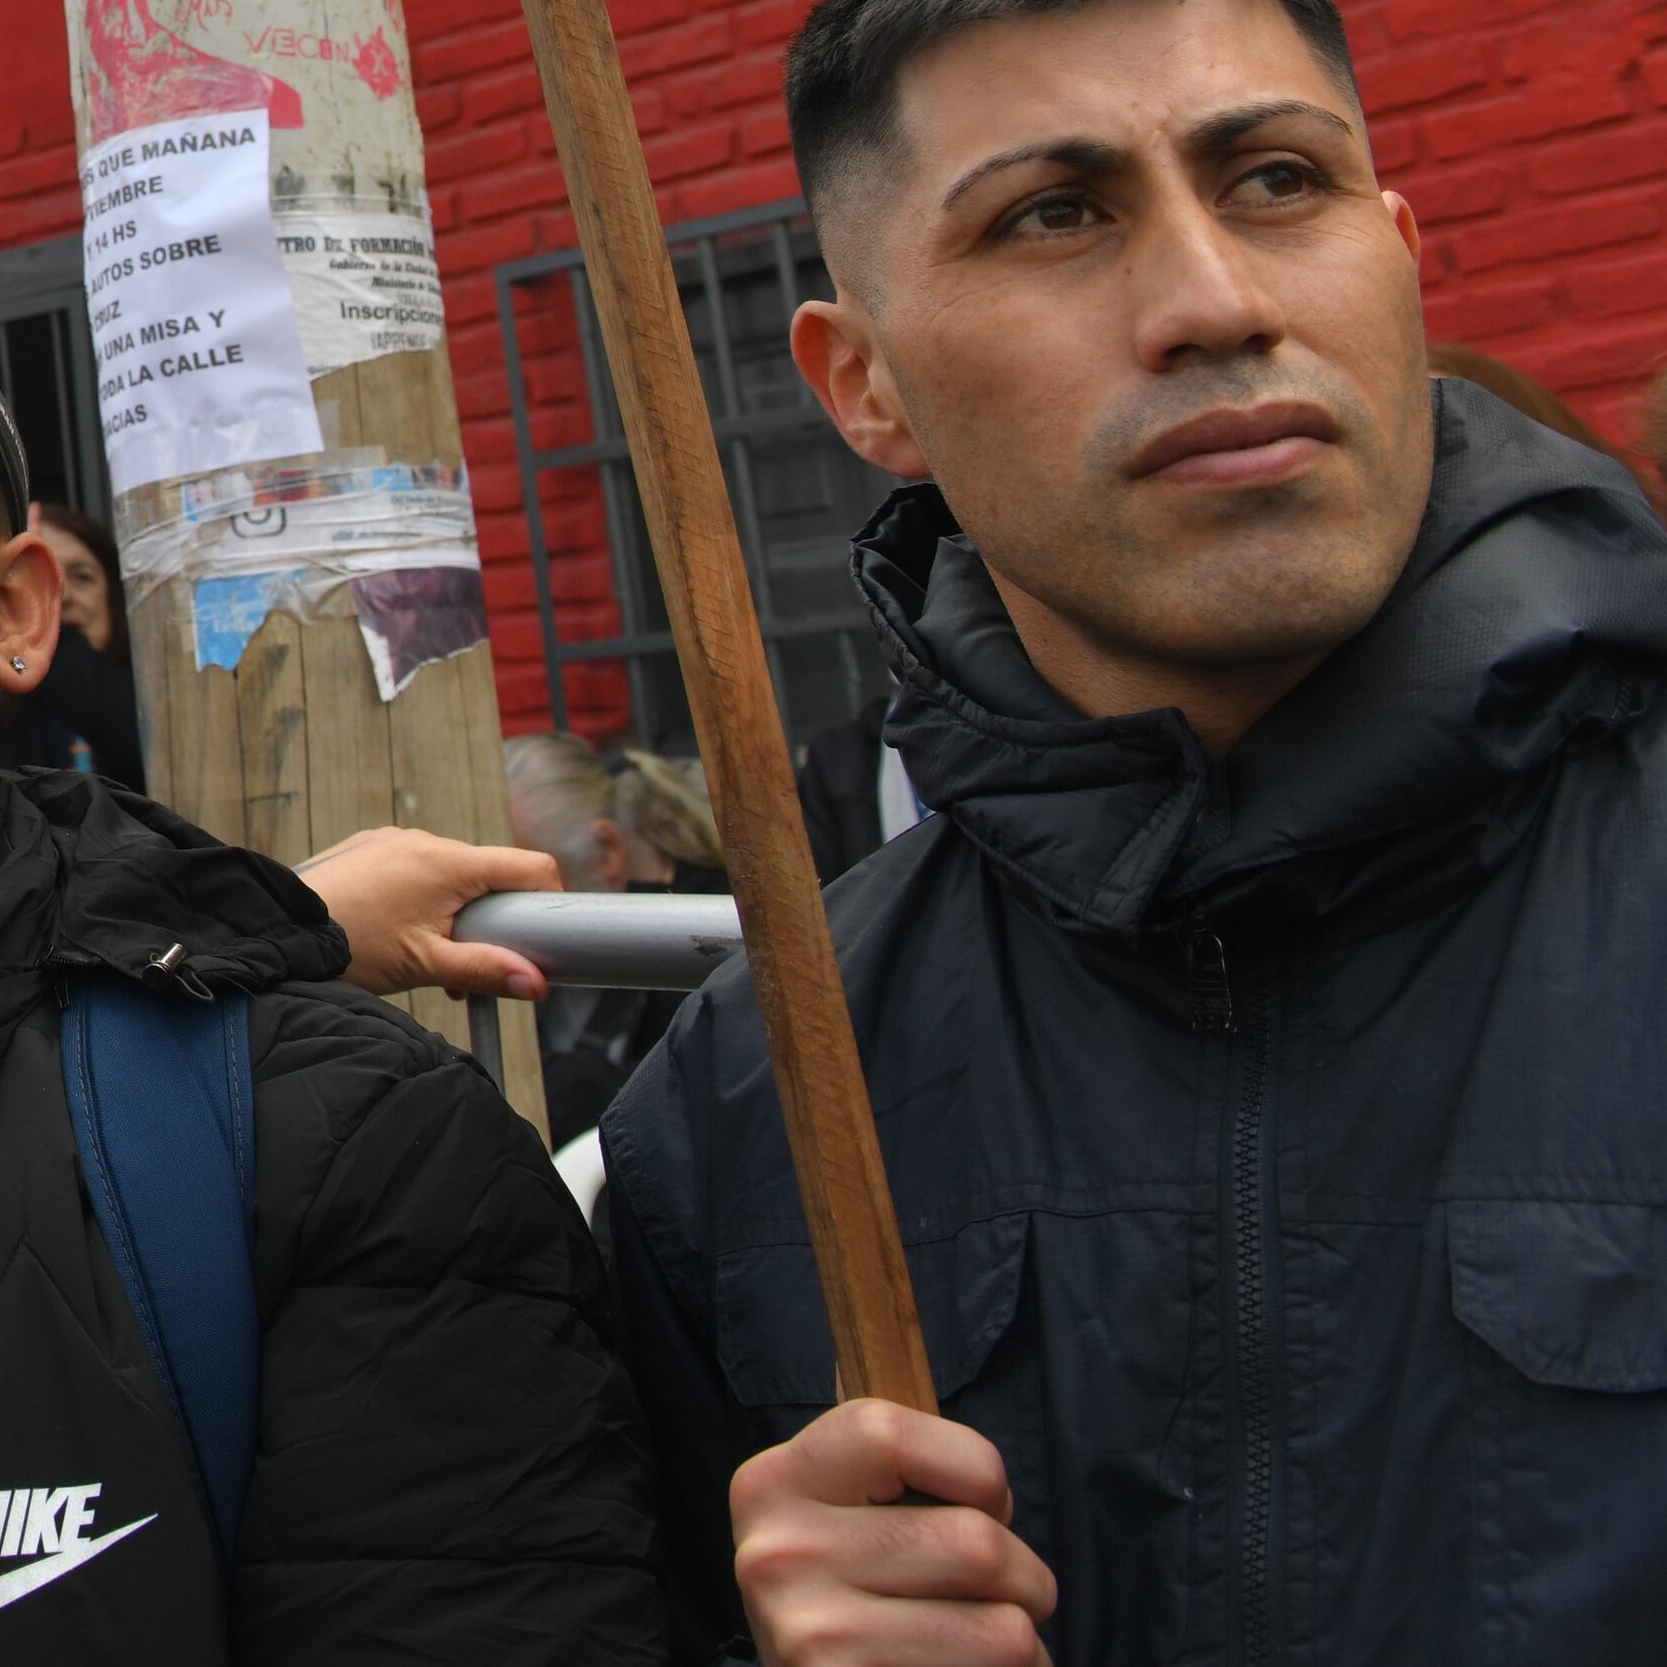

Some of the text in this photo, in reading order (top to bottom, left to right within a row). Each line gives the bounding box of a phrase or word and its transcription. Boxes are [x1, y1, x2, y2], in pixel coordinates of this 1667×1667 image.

[98, 148, 135, 178] QUE
[141, 127, 256, 161] MAÑANA
[113, 220, 137, 244] HS
[91, 234, 223, 296] AUTOS SOBRE
[104, 333, 135, 362] UNA
[140, 315, 200, 346] MISA
[208, 309, 226, 328] Y
[99, 344, 245, 402] ODA LA CALLE
[103, 403, 148, 438] ACIAS
